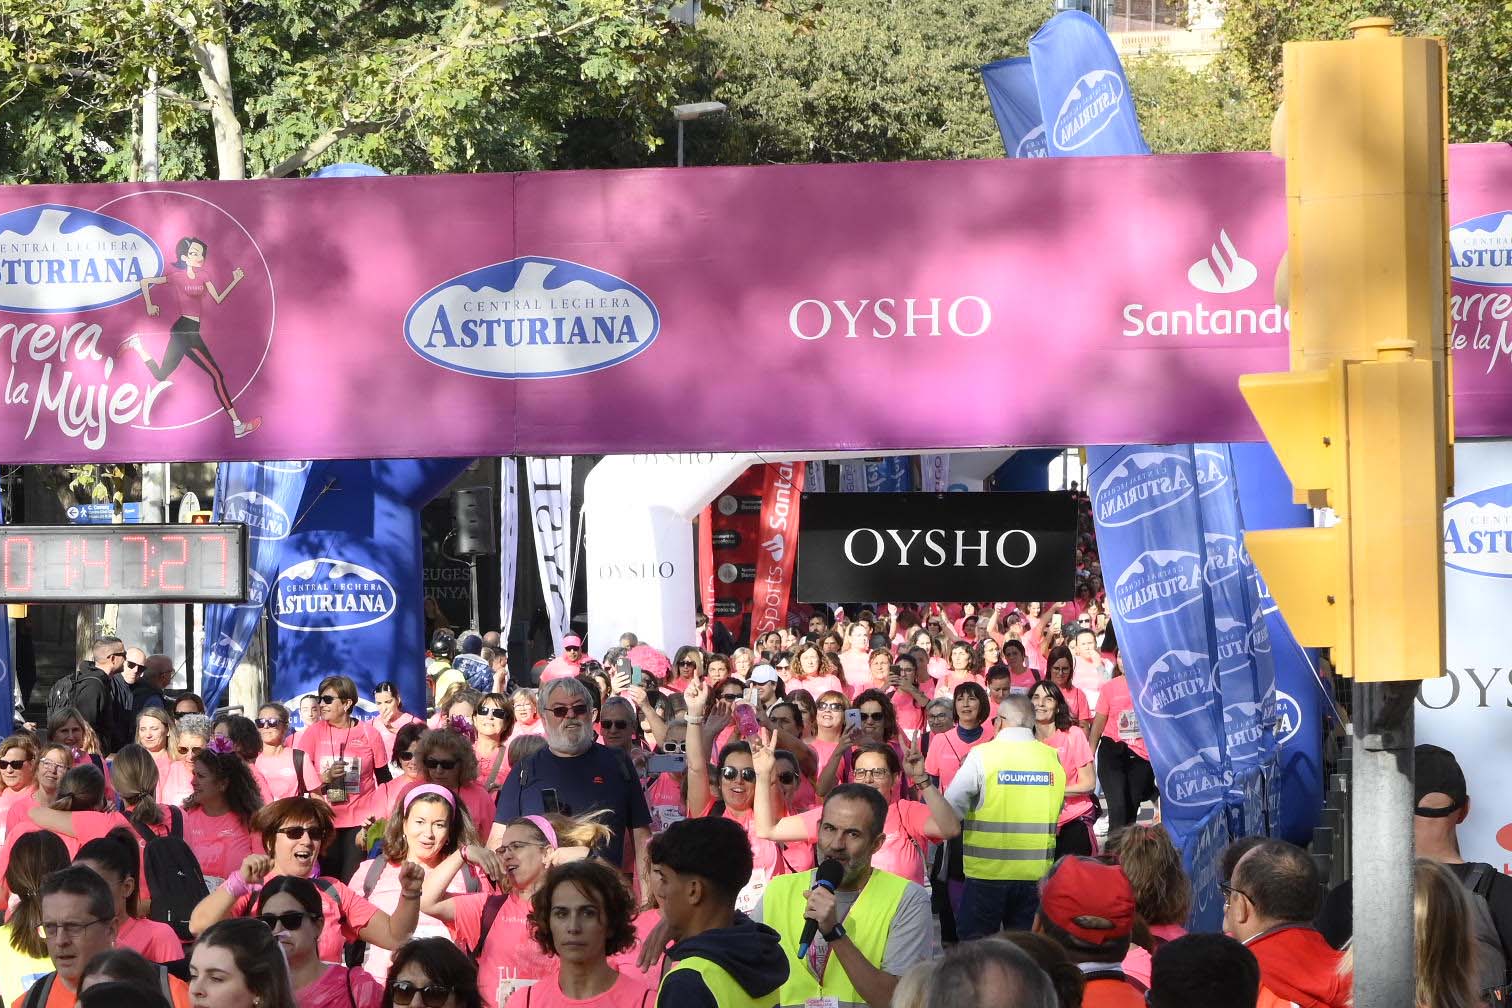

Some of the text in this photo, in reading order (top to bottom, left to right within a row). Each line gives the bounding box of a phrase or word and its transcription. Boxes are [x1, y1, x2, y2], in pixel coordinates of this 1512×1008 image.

[464, 298, 632, 312] CENTRAL LECHERA
[788, 295, 992, 340] OYSHO
[1451, 292, 1512, 322] arre
[424, 304, 640, 348] ASTURIANA
[1473, 322, 1490, 349] la
[4, 364, 29, 405] la
[24, 363, 174, 450] Mujer
[756, 462, 794, 633] Sports Santa
[844, 527, 1037, 568] OYSHO
[274, 591, 388, 615] ASTURIANA
[286, 584, 329, 592] CENTRAL
[999, 773, 1049, 783] VOLUNTARIS
